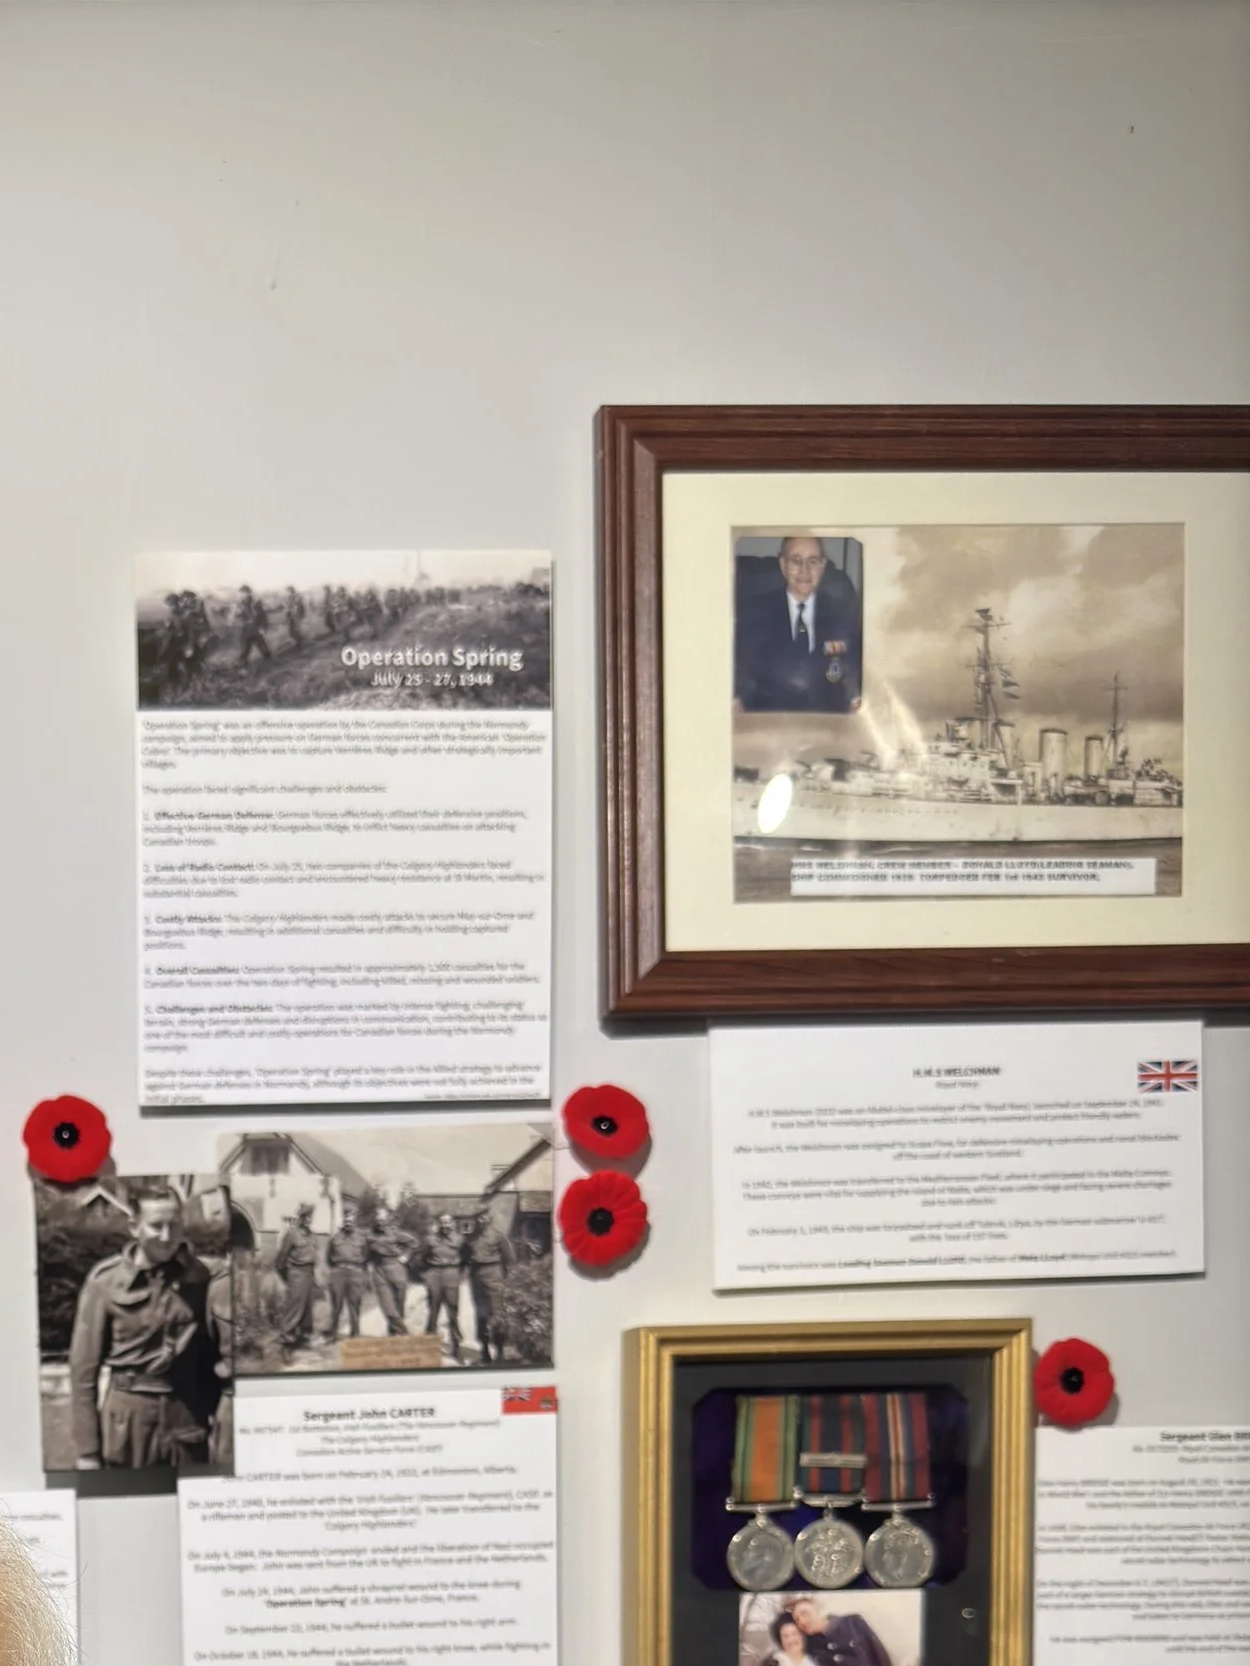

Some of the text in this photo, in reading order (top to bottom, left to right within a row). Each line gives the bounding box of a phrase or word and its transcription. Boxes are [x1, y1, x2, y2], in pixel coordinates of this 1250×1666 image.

[340, 644, 523, 671] Operation Spring
[371, 672, 402, 689] July
[458, 673, 493, 687] 1944
[303, 1407, 436, 1422] Sergeant John CARTER
